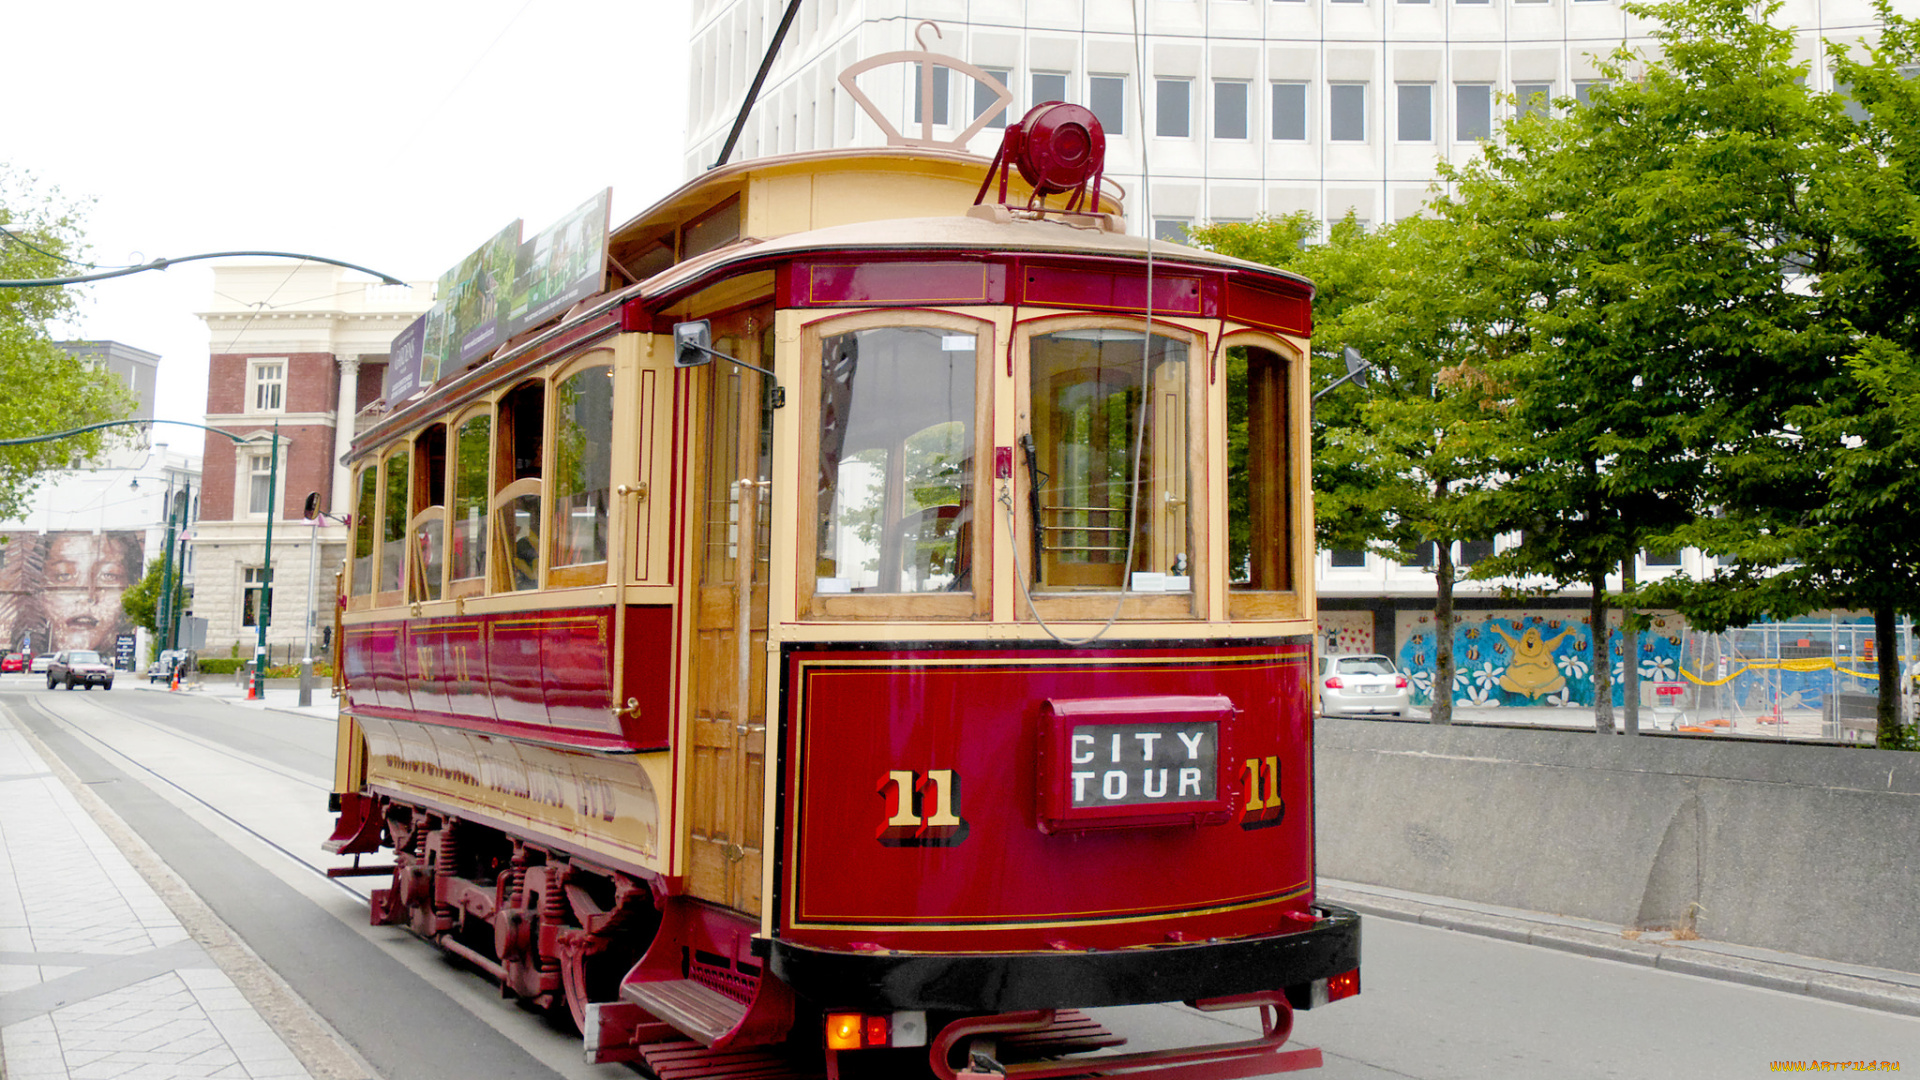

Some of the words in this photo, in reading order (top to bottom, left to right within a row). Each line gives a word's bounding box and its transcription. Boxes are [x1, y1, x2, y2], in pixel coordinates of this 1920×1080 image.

[454, 645, 470, 682] 11
[1071, 732, 1204, 764] CITY
[884, 768, 964, 836] 11
[1071, 767, 1202, 802] TOUR
[1243, 755, 1283, 818] 11
